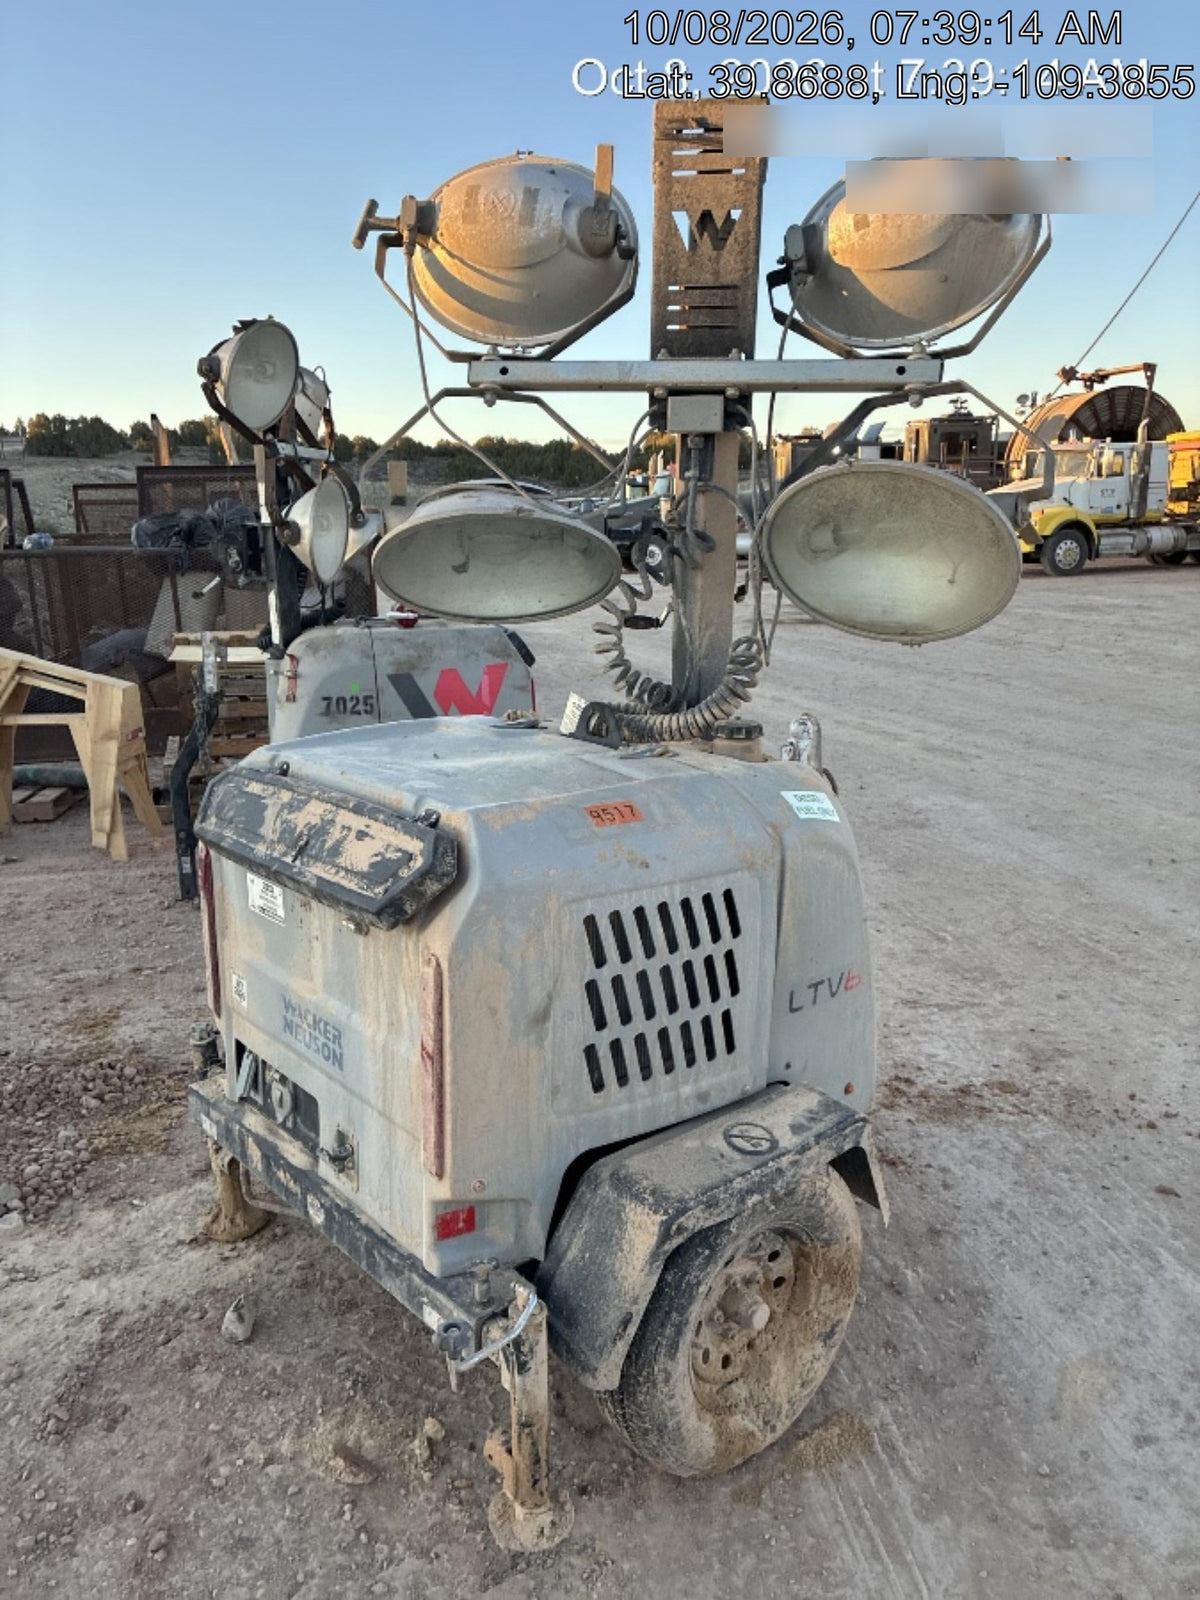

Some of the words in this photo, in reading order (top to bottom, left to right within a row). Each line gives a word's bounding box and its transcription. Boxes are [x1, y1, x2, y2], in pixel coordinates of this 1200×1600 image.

[320, 695, 375, 717] 7025
[589, 804, 636, 822] 9517
[282, 1014, 344, 1072] NEUSON
